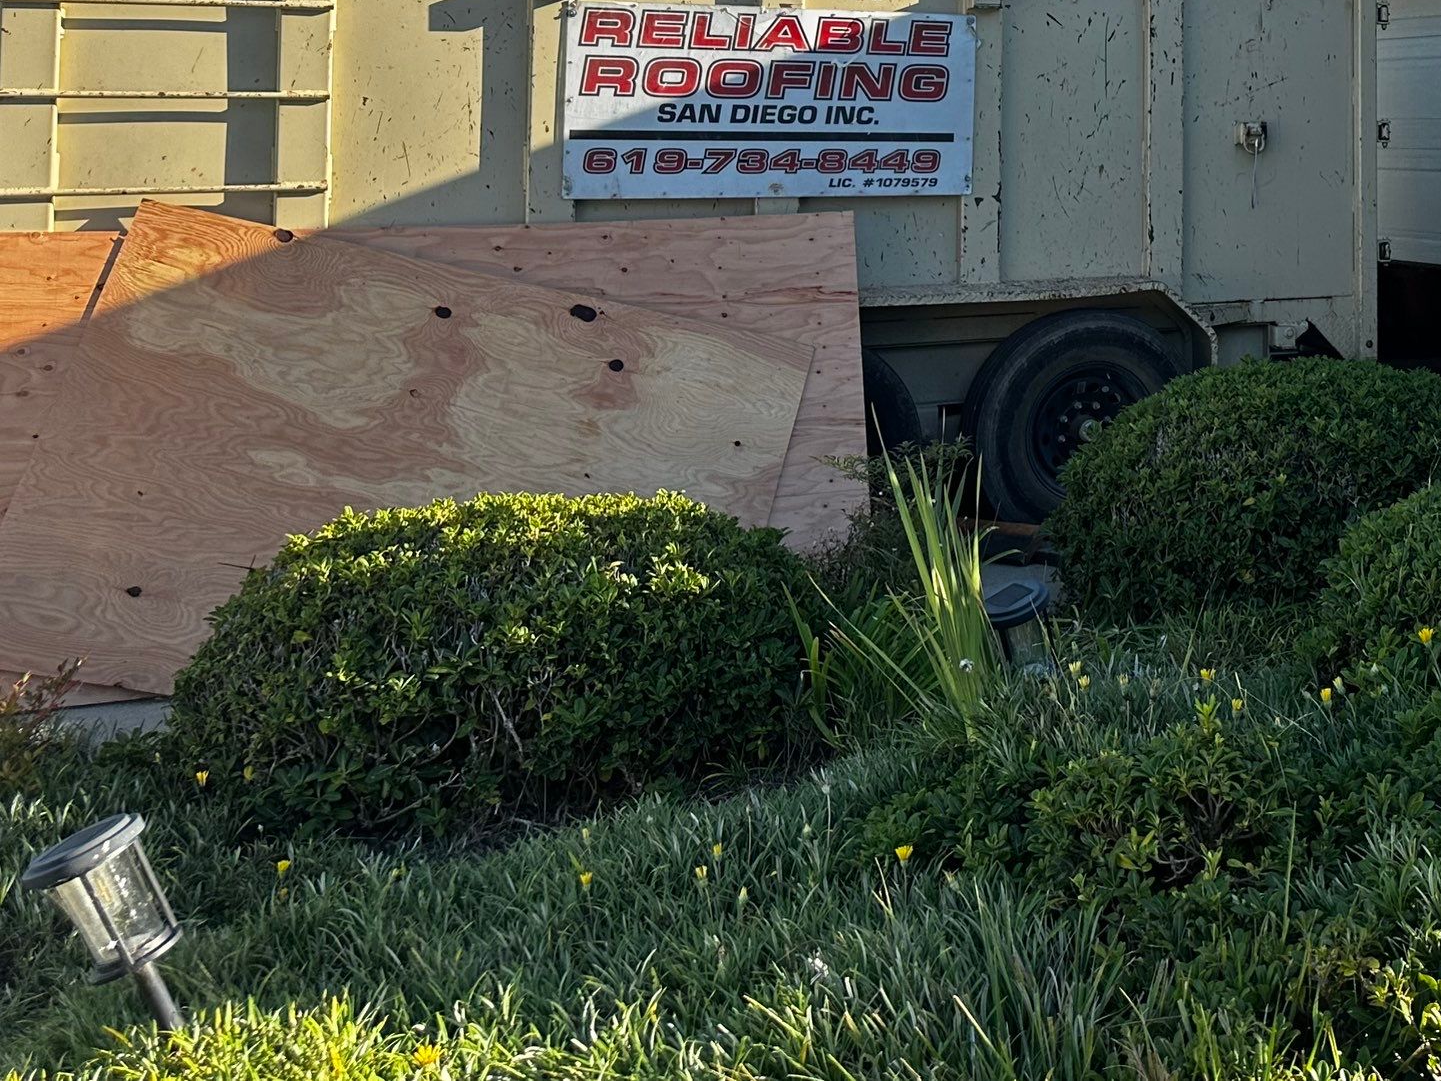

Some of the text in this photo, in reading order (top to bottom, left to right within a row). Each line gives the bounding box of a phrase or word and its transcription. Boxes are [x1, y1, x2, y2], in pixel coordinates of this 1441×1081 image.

[578, 6, 953, 57] RELIABLE
[578, 54, 949, 102] ROOFING
[657, 103, 879, 125] SAN DIEGO INC.
[583, 147, 942, 174] 619-734-8449
[828, 177, 938, 188] LIC. #1079579
